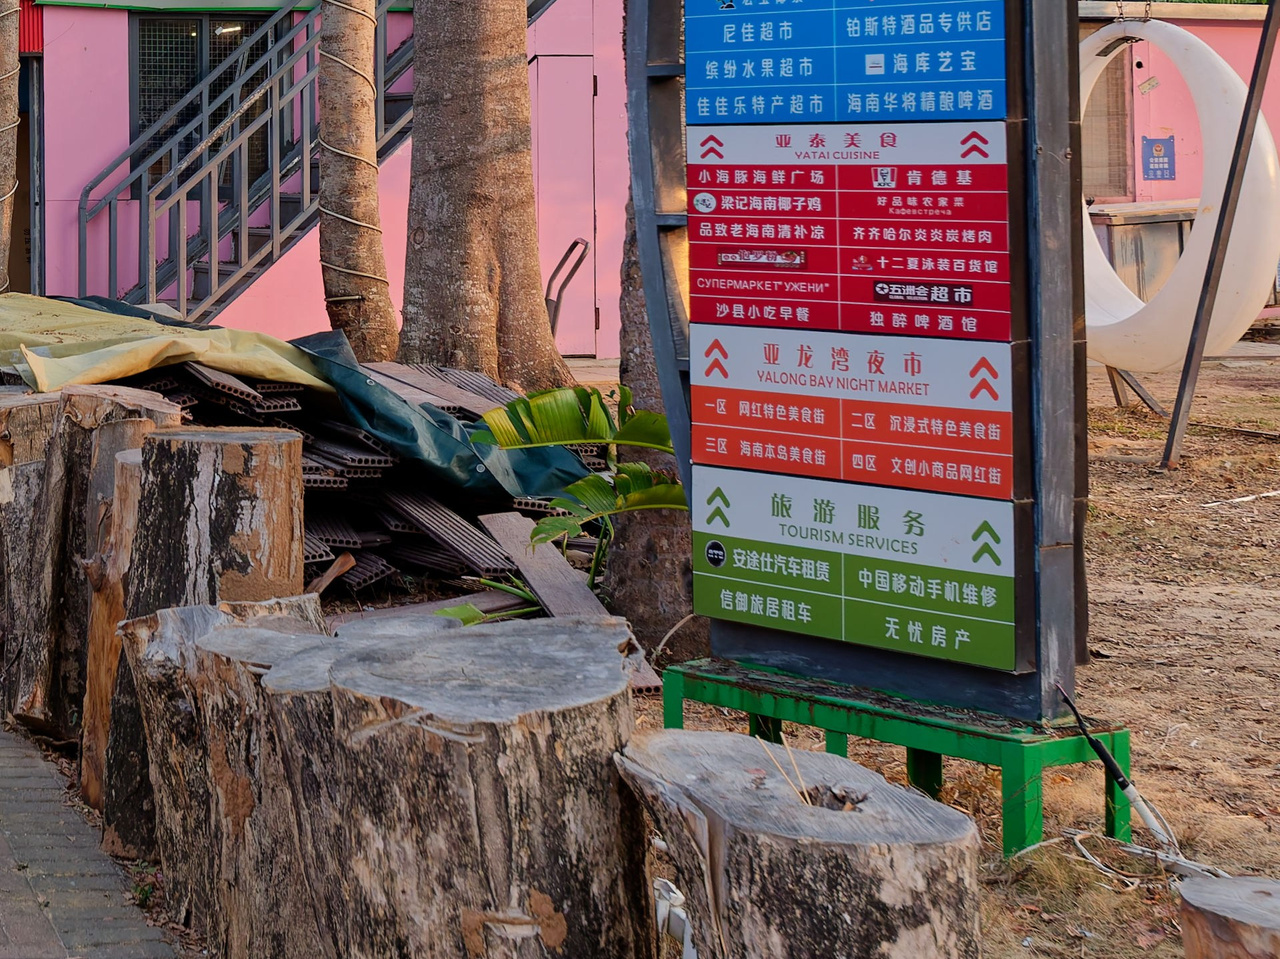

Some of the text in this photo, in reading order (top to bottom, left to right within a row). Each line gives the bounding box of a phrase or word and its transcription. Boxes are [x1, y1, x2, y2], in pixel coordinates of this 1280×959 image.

[723, 21, 793, 43] 尼佳超市
[846, 10, 992, 37] 铂斯特酒品专供店
[705, 57, 813, 79] 缤纷水果超市
[893, 50, 976, 74] 海库艺宝
[697, 94, 823, 116] 佳佳乐特产超市
[847, 89, 993, 114] 海南华将精酿啤酒
[775, 132, 898, 149] 亚泰美食
[795, 151, 880, 160] YATAI CUISINE
[698, 169, 825, 185] 小海豚海鲜广场
[906, 170, 972, 186] 肯德基
[721, 195, 822, 211] 梁记海南椰子鸡
[699, 222, 825, 239] 品致老海南清补凉
[853, 227, 992, 244] 齐齐哈尔炎炎炭烤肉
[877, 256, 998, 274] 十二夏泳装百货馆
[716, 303, 810, 321] 沙县小吃早餐
[870, 311, 978, 332] 独醉啤酒馆
[763, 343, 922, 377] 亚龙湾夜市
[757, 370, 930, 396] YALONG BAY NIGHT MARKET
[704, 398, 825, 425] 一区 网红特色美食街
[851, 412, 1001, 441] 二区 沉浸式特色美食街
[705, 437, 826, 466] 三区 海南本岛美食街
[852, 453, 1002, 485] 四区 文创小商品网红街
[771, 493, 925, 538] 旅游服务
[779, 523, 918, 555] TOURISM SERVICES
[732, 548, 830, 583] 安途仕汽车租赁
[858, 567, 997, 608] 中国移动手机维修
[720, 589, 812, 623] 信御旅居租车
[885, 616, 971, 650] 无忧房产
